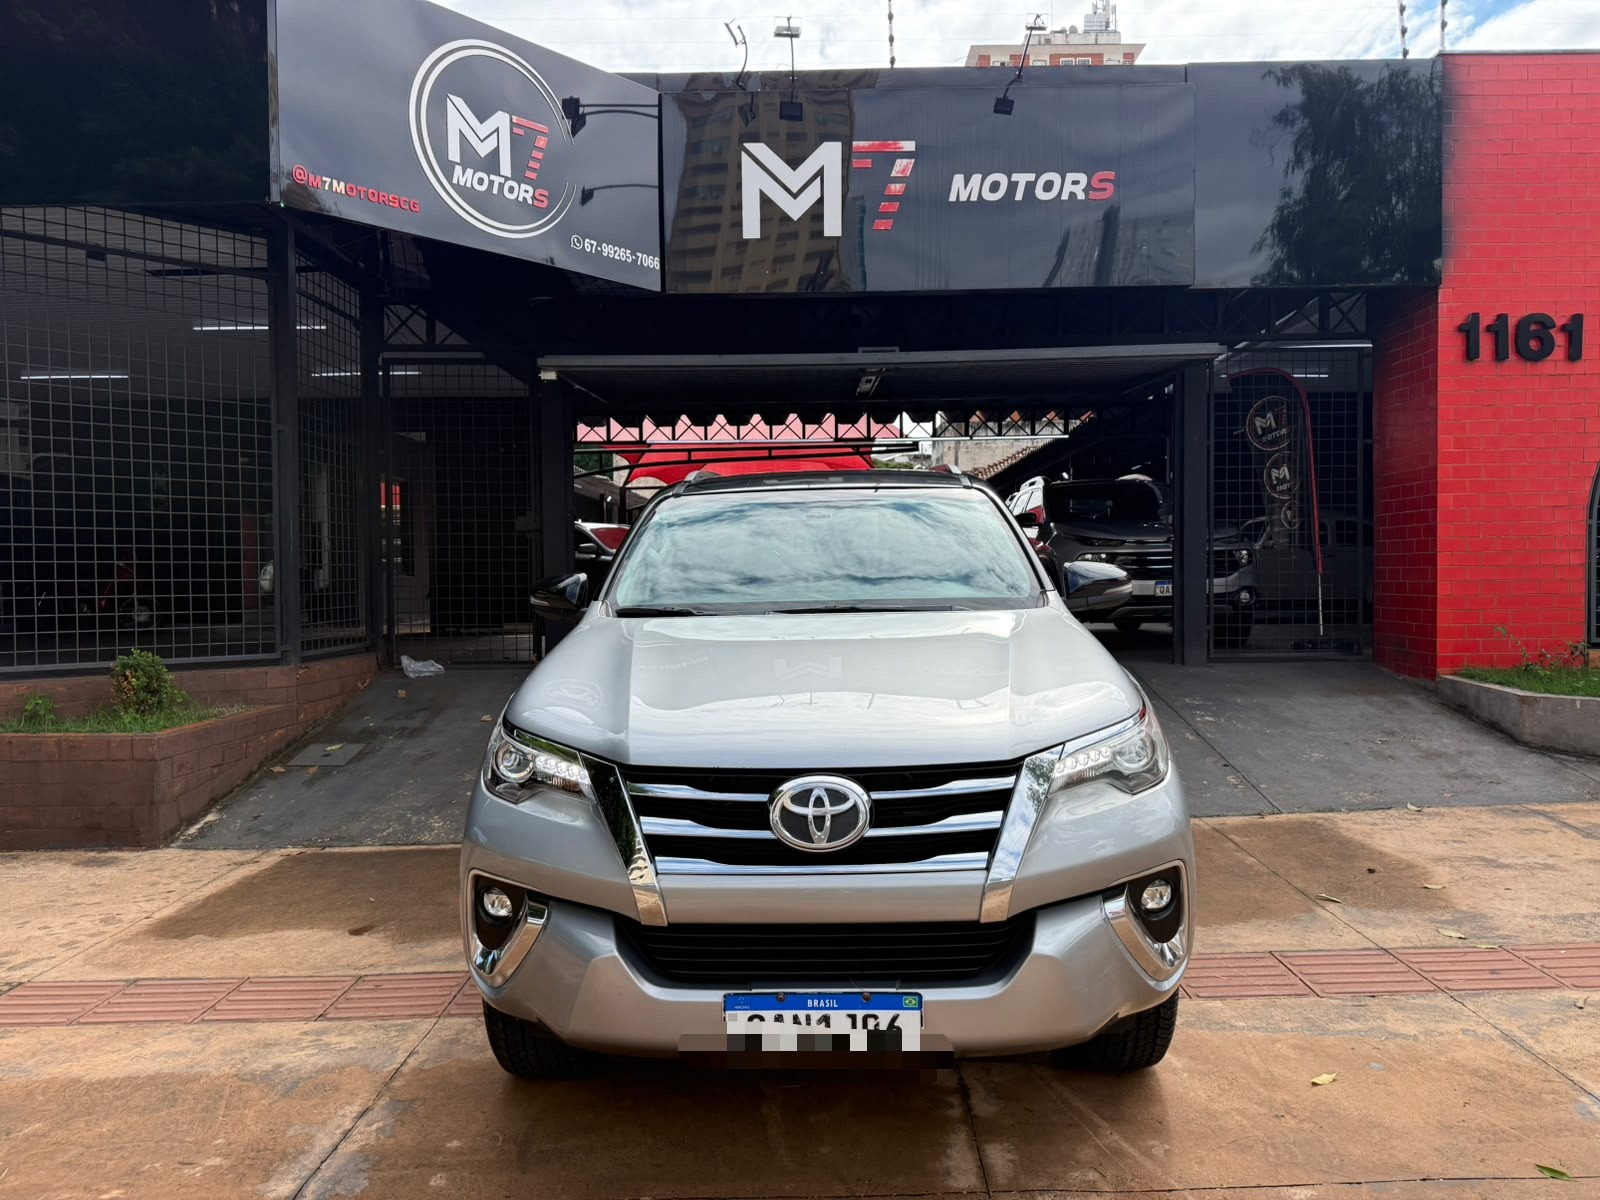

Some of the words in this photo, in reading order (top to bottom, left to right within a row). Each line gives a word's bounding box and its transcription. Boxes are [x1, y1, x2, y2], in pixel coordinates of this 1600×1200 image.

[292, 164, 420, 213] @M7MOTORSCG
[452, 164, 549, 209] MOTORS
[741, 140, 916, 239] M7
[949, 171, 1116, 203] MOTORS
[584, 238, 660, 270] 67-99265-7066
[1457, 312, 1584, 362] 1161
[807, 999, 838, 1008] BRASIL
